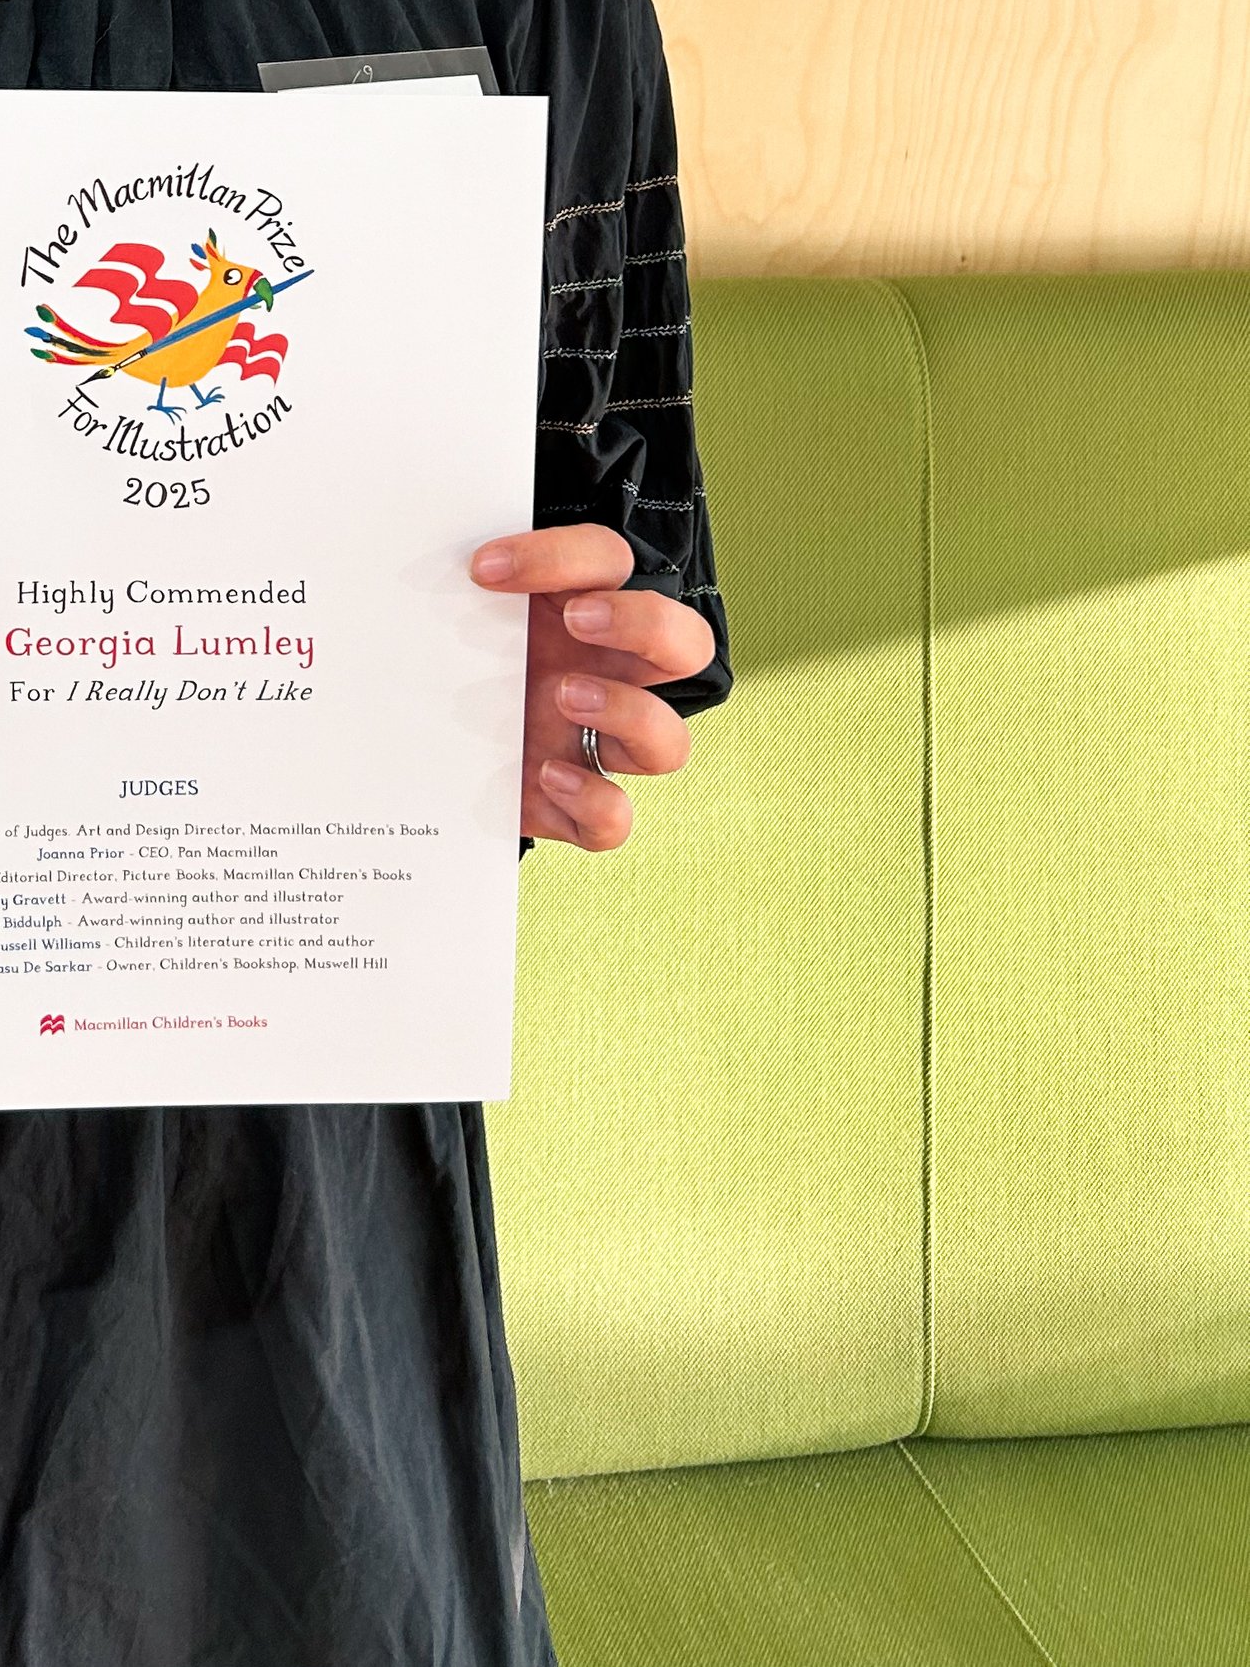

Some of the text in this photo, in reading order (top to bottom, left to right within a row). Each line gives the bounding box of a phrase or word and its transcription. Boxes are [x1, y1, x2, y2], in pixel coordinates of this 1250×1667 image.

[21, 163, 305, 287] The Macmillan Prize
[58, 386, 293, 462] For Illustration
[122, 477, 211, 509] 2025
[17, 580, 306, 614] Highly Commended
[5, 625, 315, 669] Georgia Lumley
[9, 680, 313, 710] For I Really Don't Like
[119, 780, 199, 798] JUDGES
[4, 824, 20, 838] of
[76, 824, 101, 836] Art
[106, 824, 130, 836] and
[135, 824, 180, 840] Design
[250, 824, 321, 836] Macmillan
[326, 823, 395, 836] Children's
[400, 824, 439, 836] Books
[37, 848, 84, 862] Joanna
[90, 848, 125, 859] Prior
[178, 846, 202, 858] Pan
[206, 846, 278, 858] Macmillan
[122, 870, 171, 882] Picture
[223, 869, 294, 880] Macmillan
[298, 868, 368, 880] Children's
[372, 868, 412, 881] Books
[12, 894, 66, 906] Gravett
[82, 892, 188, 907] Award-winning
[192, 890, 240, 904] author
[244, 890, 268, 902] and
[273, 890, 344, 902] illustrator
[3, 916, 62, 931] Biddulph
[78, 914, 184, 929] Award-winning
[188, 914, 236, 926] author
[240, 913, 264, 925] and
[268, 913, 340, 925] illustrator
[42, 938, 102, 950] Williams
[114, 936, 184, 948] Children's
[188, 935, 254, 948] literature
[258, 936, 294, 948] critic
[298, 935, 324, 947] and
[328, 935, 375, 947] author
[24, 962, 41, 974] De
[45, 961, 93, 973] Sarkar
[160, 958, 229, 970] Children's
[304, 957, 358, 970] Muswell
[363, 957, 388, 970] Hill
[74, 1016, 268, 1031] Macmillan Children's Books
